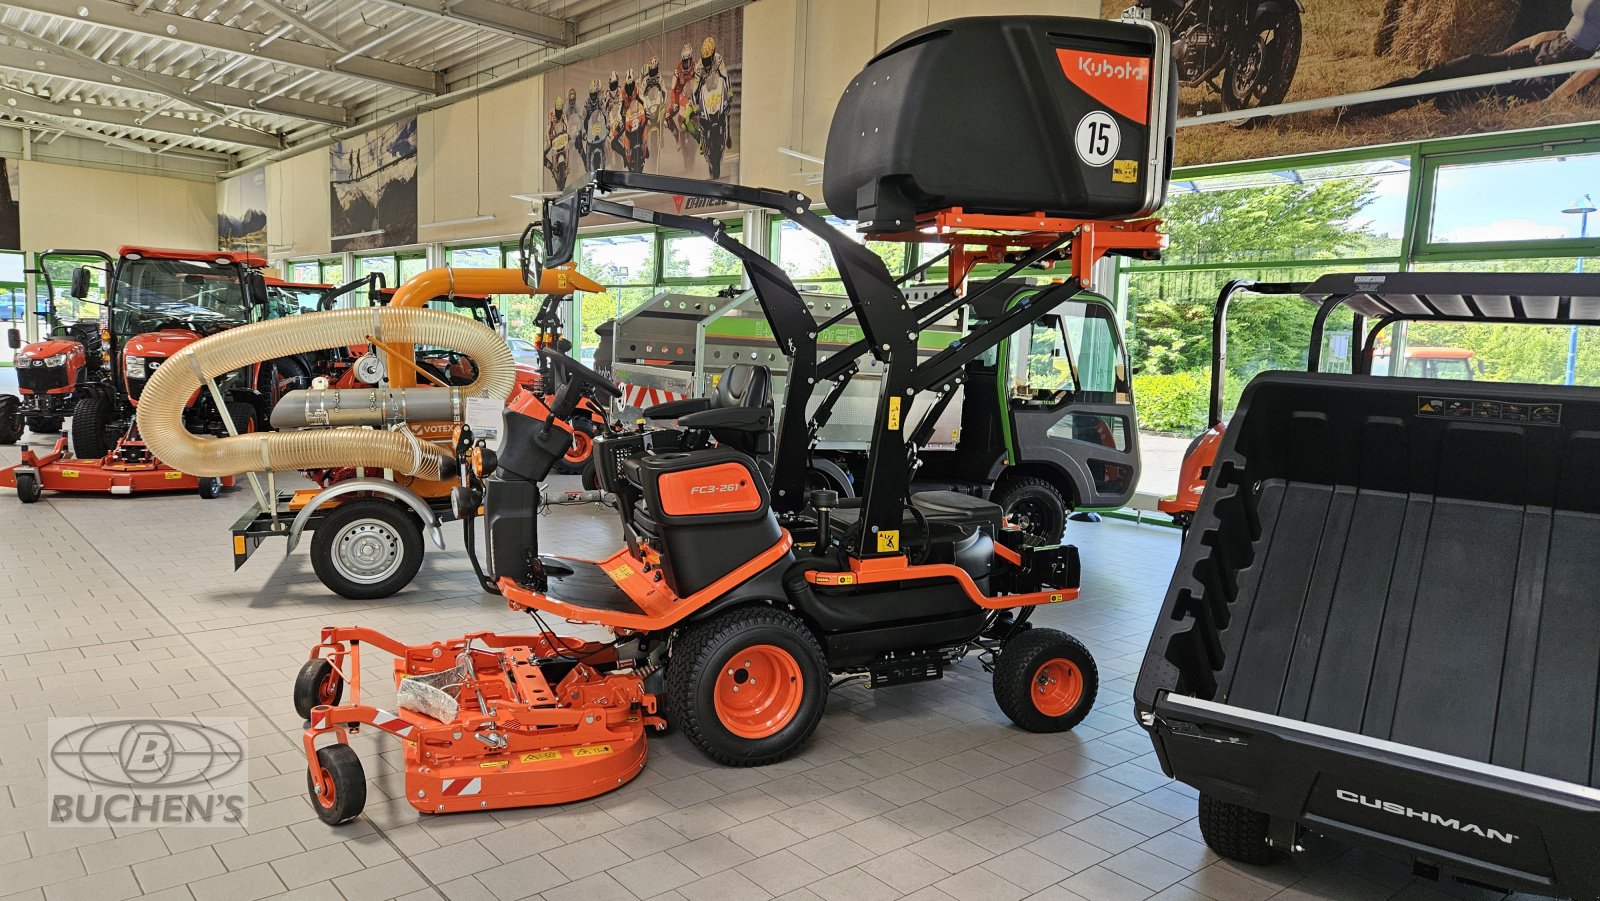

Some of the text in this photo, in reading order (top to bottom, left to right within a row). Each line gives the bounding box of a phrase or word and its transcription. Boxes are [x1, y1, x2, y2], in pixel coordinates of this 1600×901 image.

[1078, 56, 1145, 80] Kubota
[1088, 121, 1111, 156] 15
[423, 424, 454, 433] VOTEX
[690, 483, 740, 495] FC3-261
[1336, 789, 1513, 844] CUSHMAN
